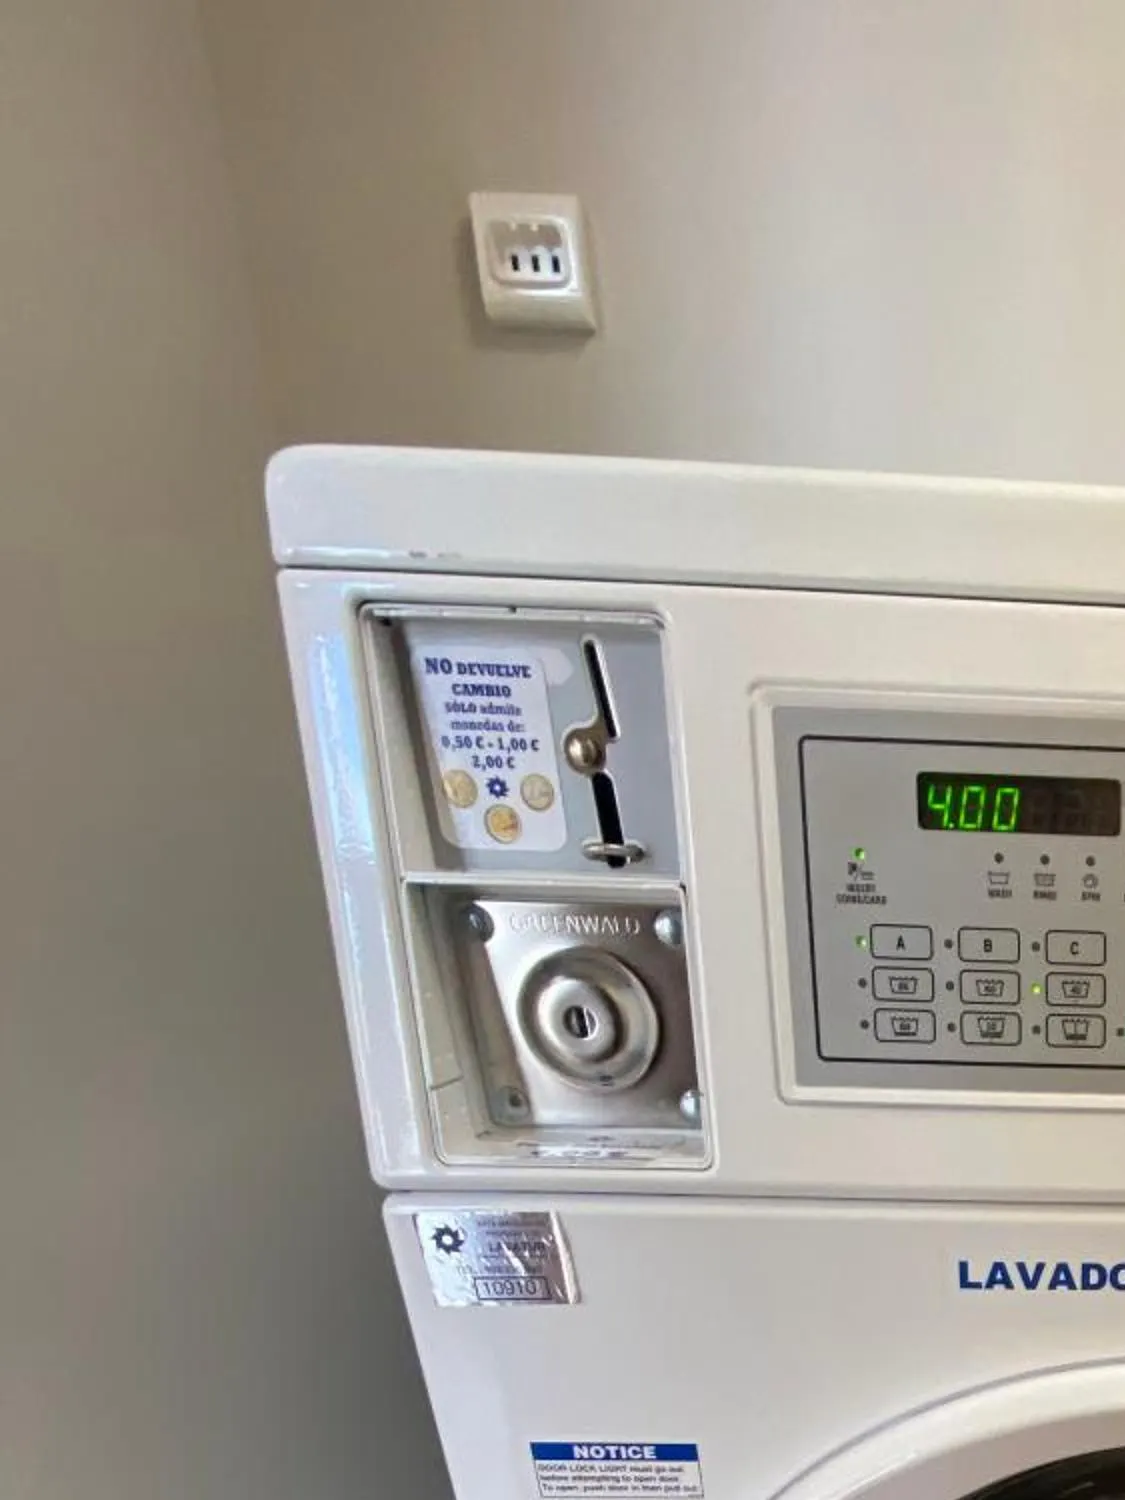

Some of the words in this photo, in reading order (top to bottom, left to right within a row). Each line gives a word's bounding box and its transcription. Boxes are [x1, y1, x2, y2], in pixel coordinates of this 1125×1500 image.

[424, 657, 452, 675] NO
[456, 662, 532, 679] DEVUELVE
[451, 683, 512, 698] CAMBIO
[927, 784, 1020, 831] 4.00
[896, 935, 906, 951] A
[983, 938, 993, 953] B
[1069, 941, 1079, 955] C
[488, 1240, 546, 1252] LAATUR
[483, 1280, 537, 1296] 10910
[574, 1445, 656, 1459] NOTICE
